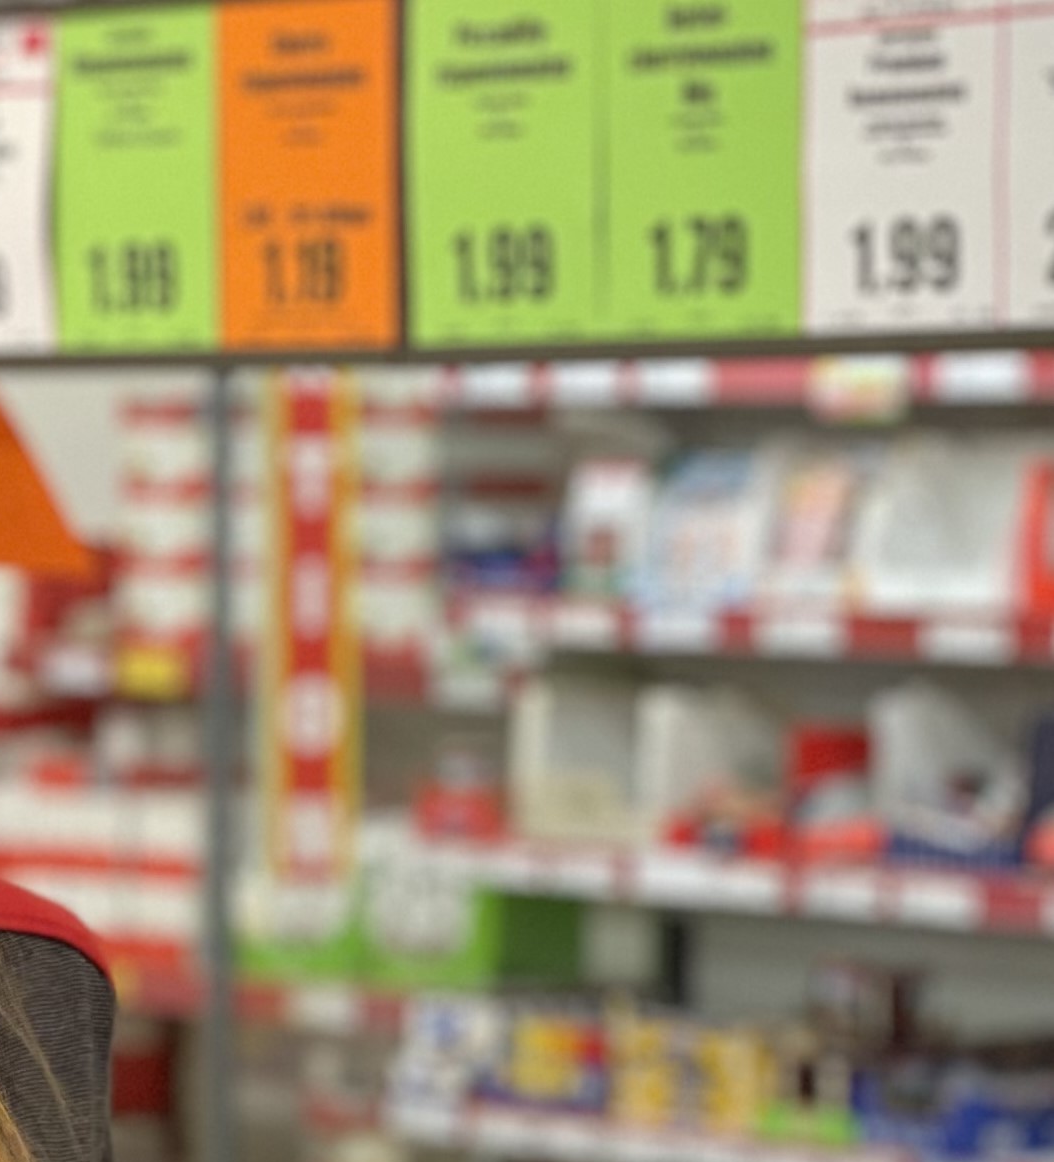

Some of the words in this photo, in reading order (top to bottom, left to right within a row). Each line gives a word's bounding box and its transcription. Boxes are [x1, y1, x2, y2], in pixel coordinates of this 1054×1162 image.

[454, 225, 554, 302] 1.99
[652, 214, 749, 297] 1.79
[853, 217, 960, 296] 1.99
